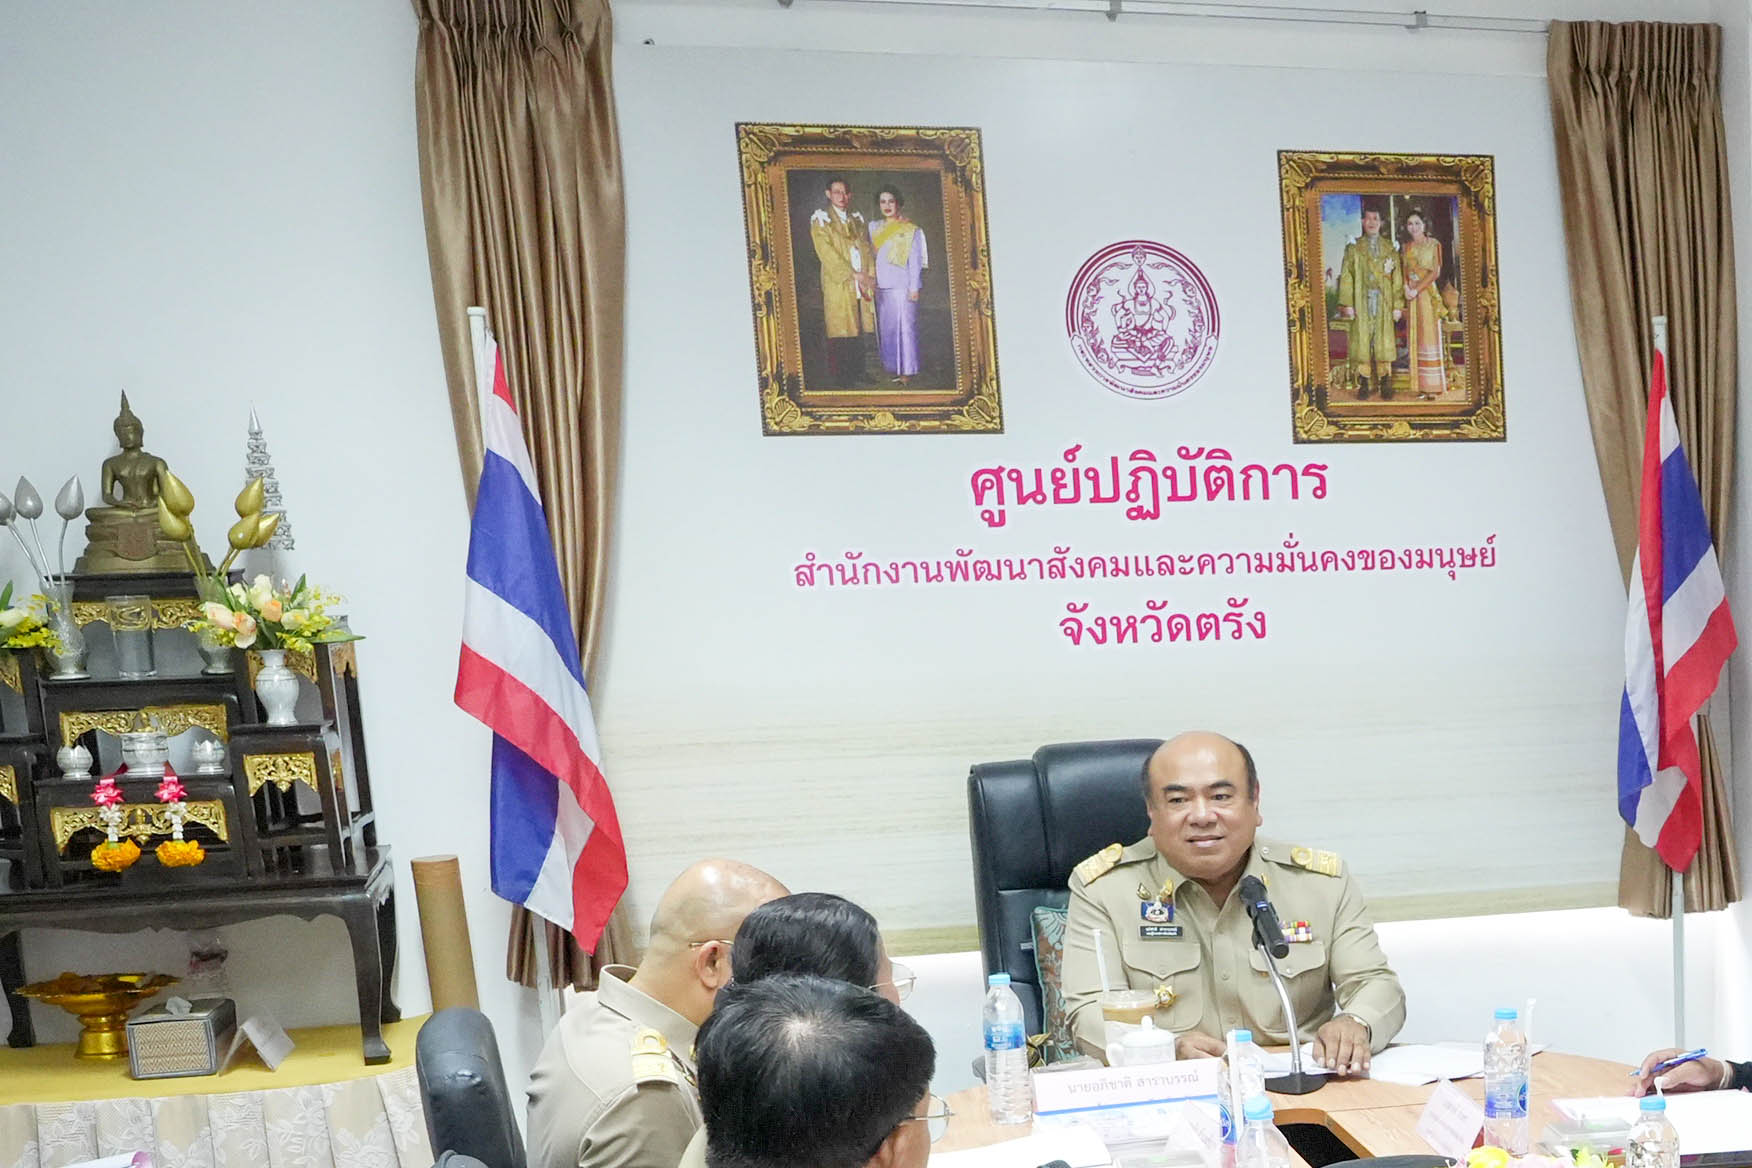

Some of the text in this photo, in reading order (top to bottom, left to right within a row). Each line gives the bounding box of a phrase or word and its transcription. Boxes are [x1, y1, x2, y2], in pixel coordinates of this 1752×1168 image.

[972, 443, 1328, 528] ศูนย์ปฏิบัติการ
[794, 533, 1497, 588] สำนักงานพัฒนาสังคมและความมั่นคงของมนุษย์
[1059, 597, 1267, 646] จังหวัดตรัง
[1067, 1077, 1132, 1094] นายอภิชาติ
